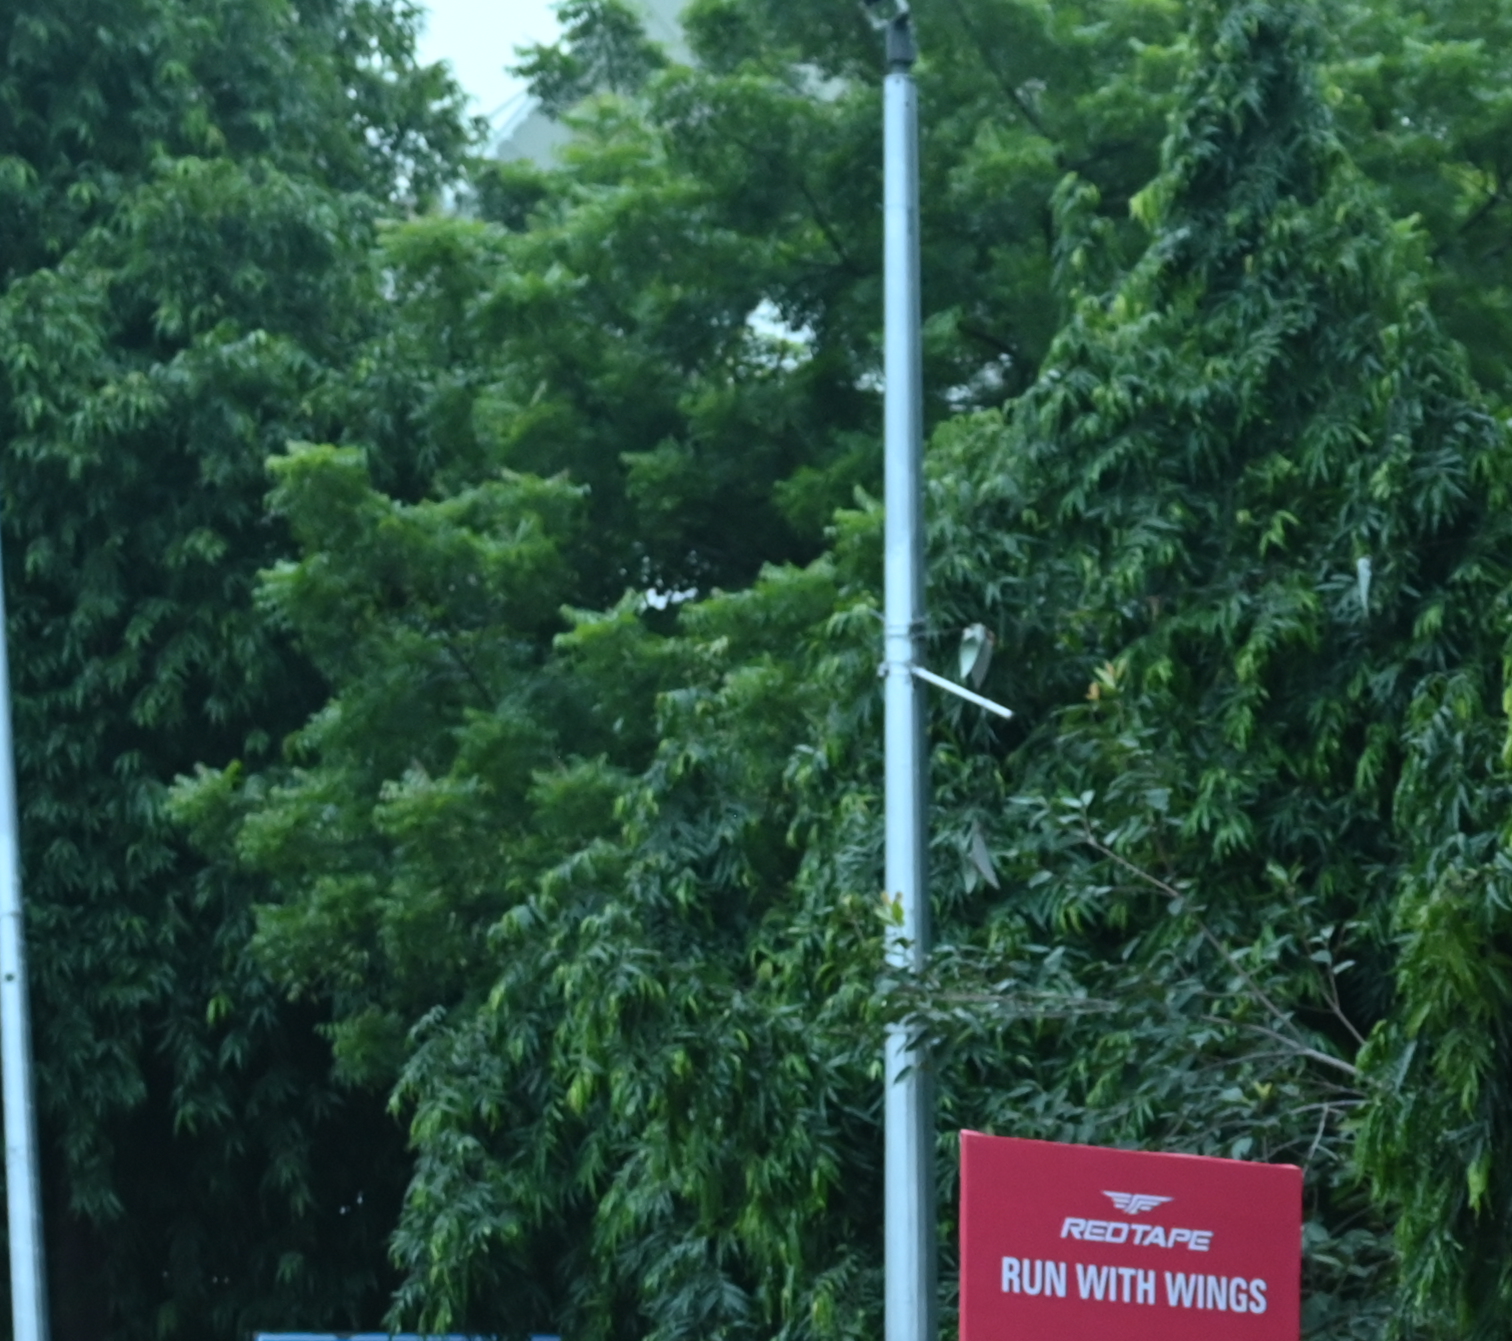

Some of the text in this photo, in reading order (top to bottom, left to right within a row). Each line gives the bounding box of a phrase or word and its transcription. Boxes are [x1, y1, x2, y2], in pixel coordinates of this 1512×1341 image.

[1060, 1217, 1213, 1251] REDTAPE
[1001, 1256, 1267, 1314] RUN WITH WINGS
